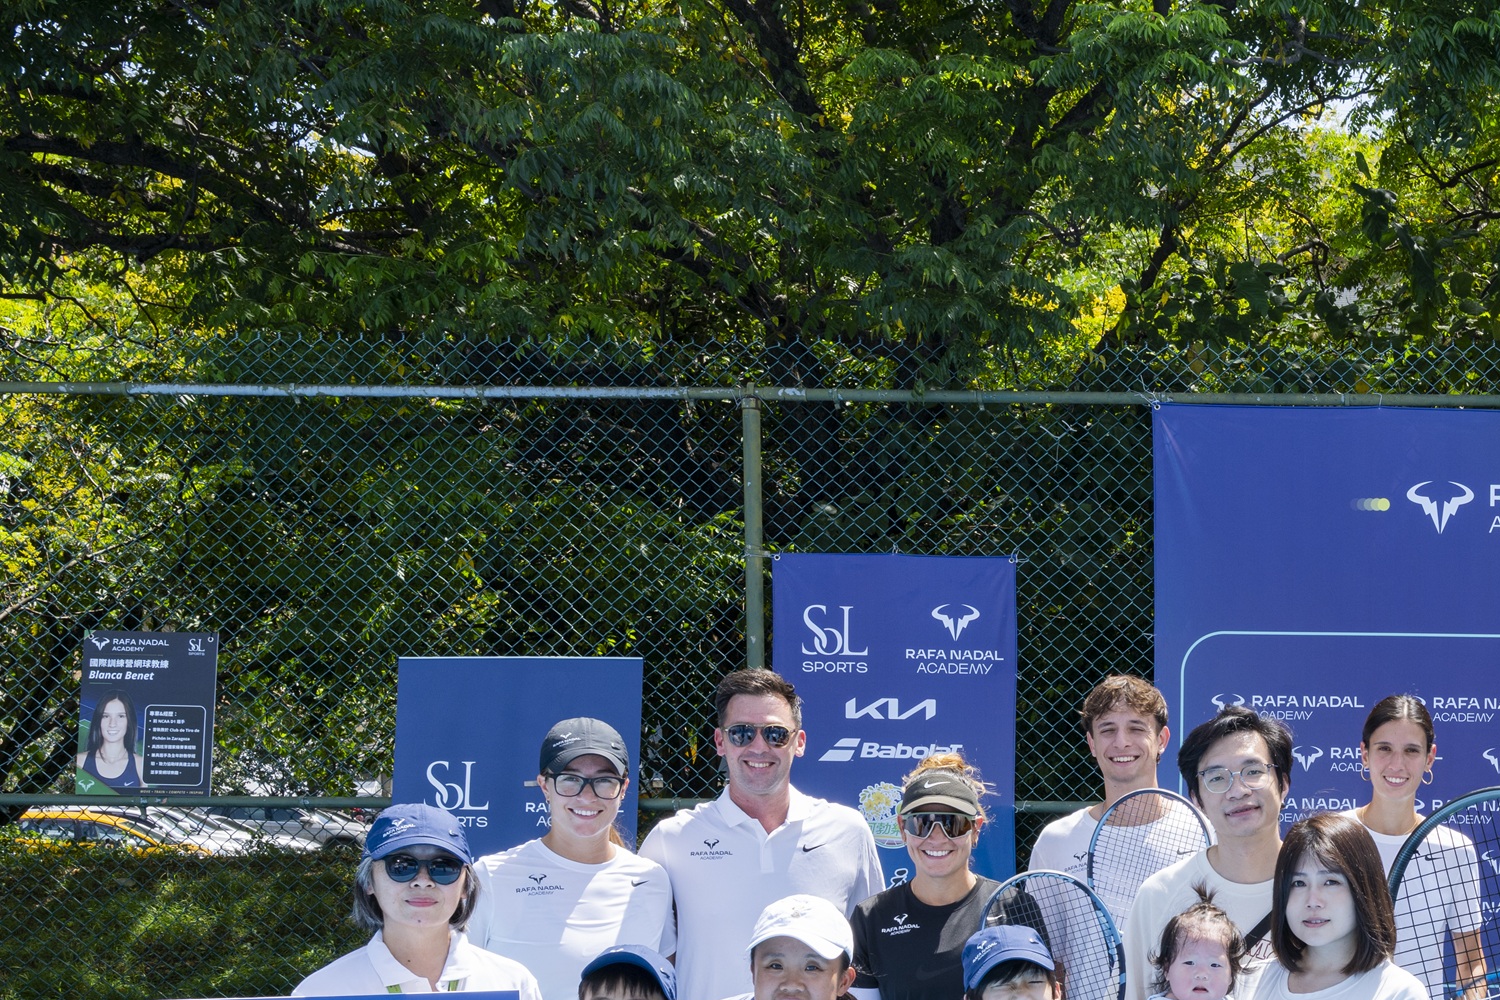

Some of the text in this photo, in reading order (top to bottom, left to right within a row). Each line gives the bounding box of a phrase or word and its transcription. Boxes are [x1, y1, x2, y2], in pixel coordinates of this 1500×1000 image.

[139, 639, 170, 647] NADAL
[905, 649, 1004, 661] RAFA NADAL
[802, 661, 868, 673] SPORTS
[917, 662, 993, 675] ACADEMY
[89, 670, 154, 680] Blanca Benet
[1252, 696, 1364, 708] RAFA NADAL
[1433, 697, 1480, 709] RAFA
[845, 697, 936, 720] KIA
[1433, 713, 1494, 722] ACADEMY
[526, 802, 550, 813] RA
[458, 816, 488, 828] RTS
